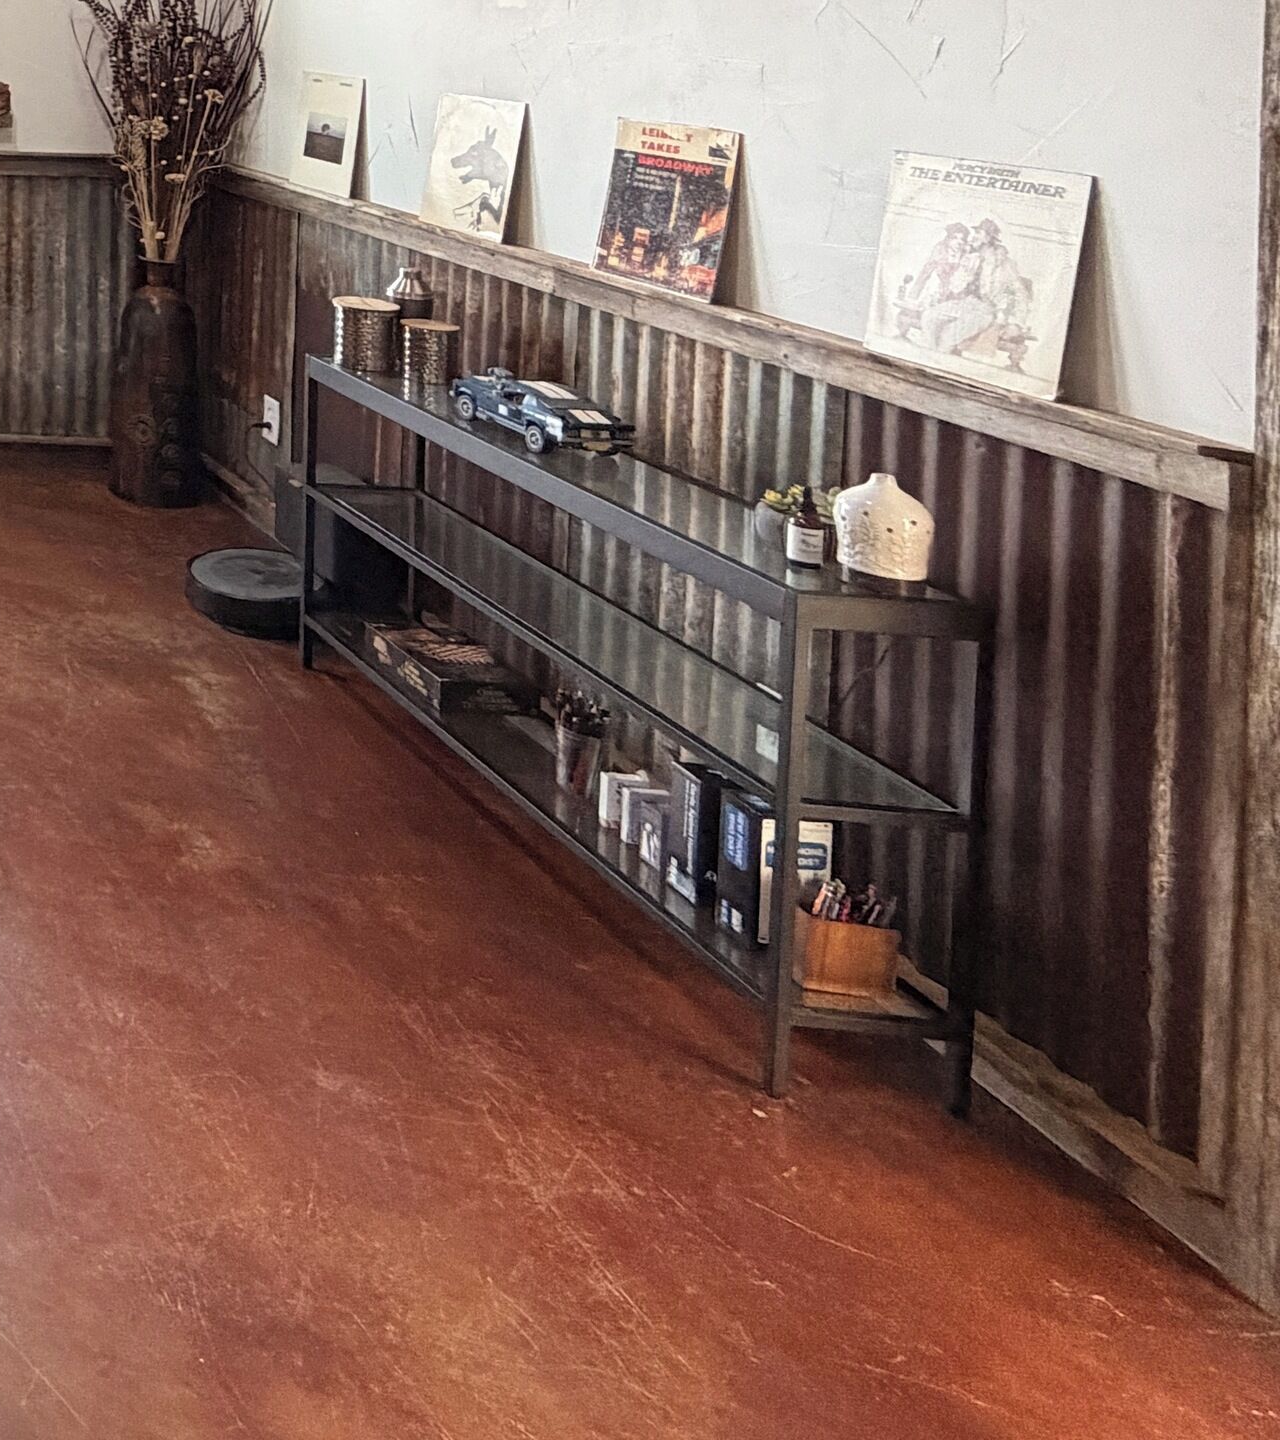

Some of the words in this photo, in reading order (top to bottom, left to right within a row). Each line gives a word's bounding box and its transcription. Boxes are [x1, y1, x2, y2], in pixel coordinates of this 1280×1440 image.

[640, 140, 681, 155] TAKES
[909, 166, 942, 181] THE
[942, 172, 1067, 199] ENTERTAINER
